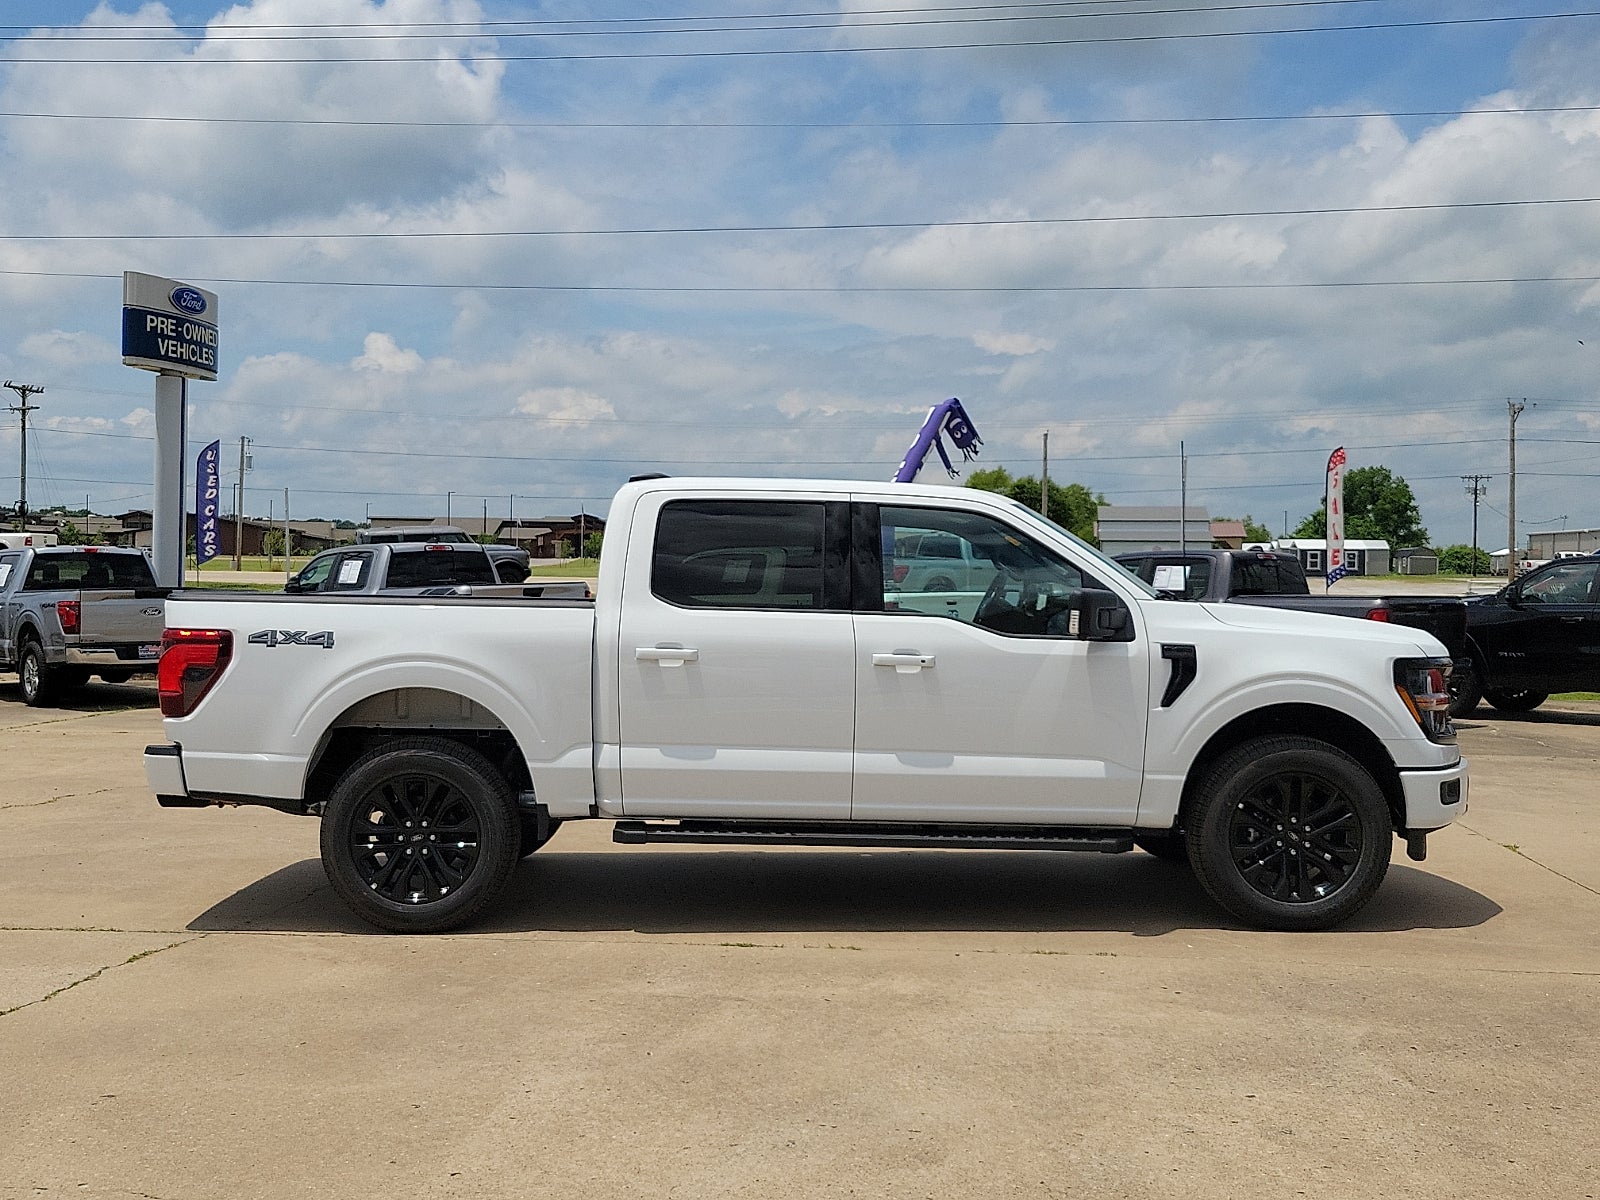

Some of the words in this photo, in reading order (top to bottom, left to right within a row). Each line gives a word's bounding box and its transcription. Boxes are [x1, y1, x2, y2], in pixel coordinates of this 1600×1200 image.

[181, 291, 203, 309] Ford
[146, 315, 217, 347] PRE-OWNED
[158, 338, 214, 365] VEHICLES
[205, 449, 218, 500] USED
[203, 504, 216, 557] CARS
